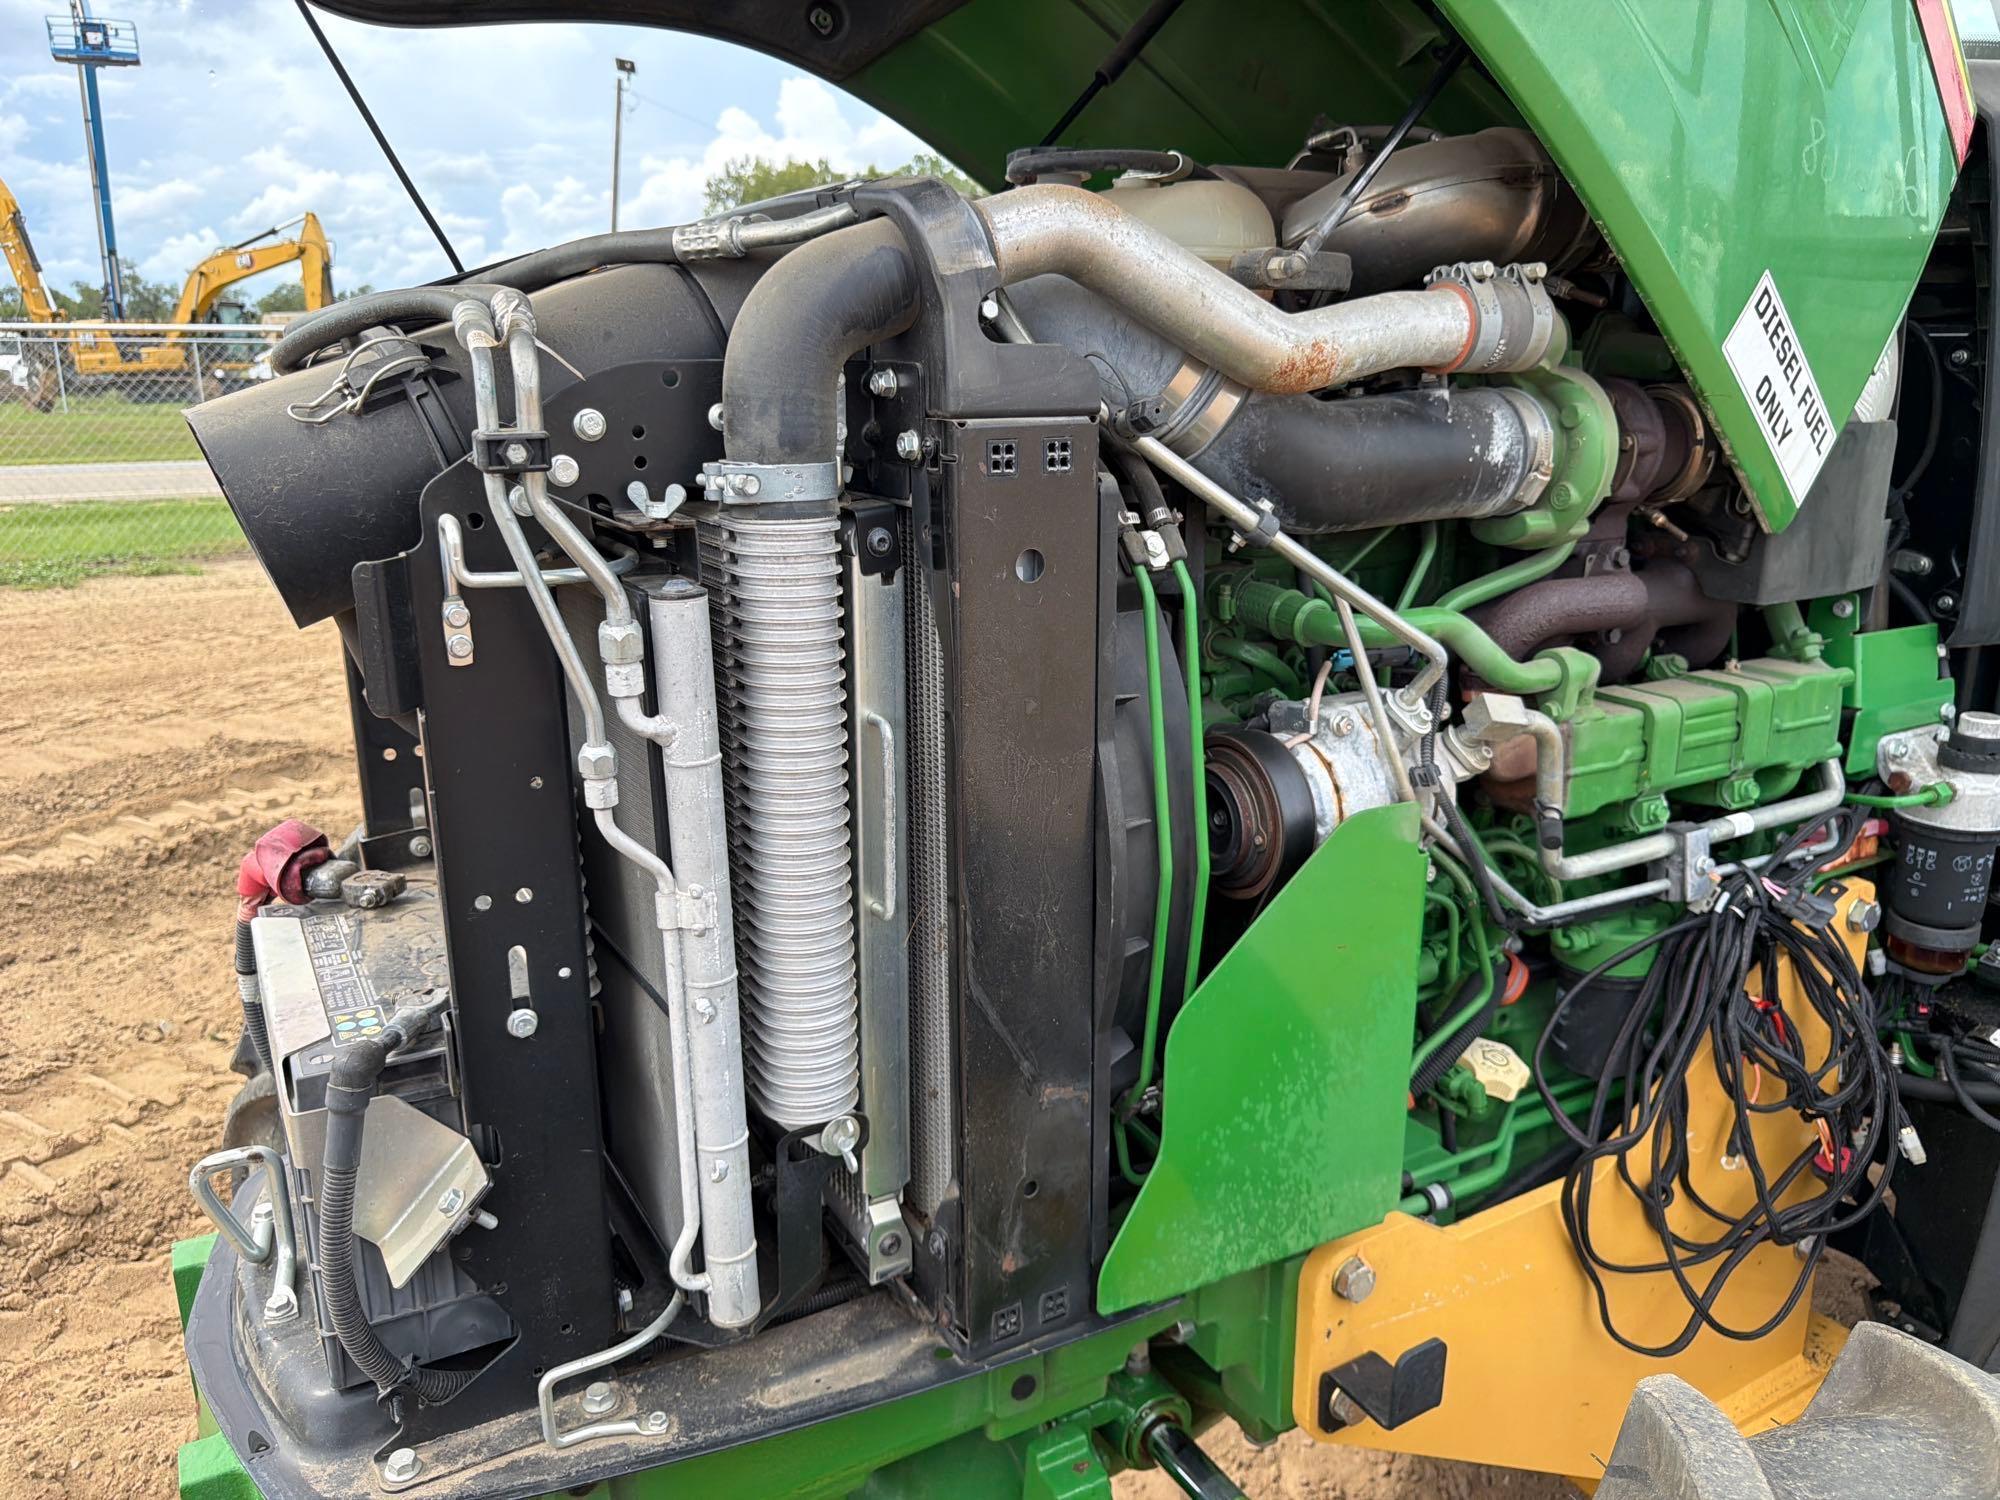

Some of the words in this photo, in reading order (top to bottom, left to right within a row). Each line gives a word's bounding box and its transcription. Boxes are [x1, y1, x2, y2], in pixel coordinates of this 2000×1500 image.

[1754, 286, 1802, 396] DIESEL
[1798, 384, 1829, 457] FUEL
[1755, 375, 1794, 447] ONLY
